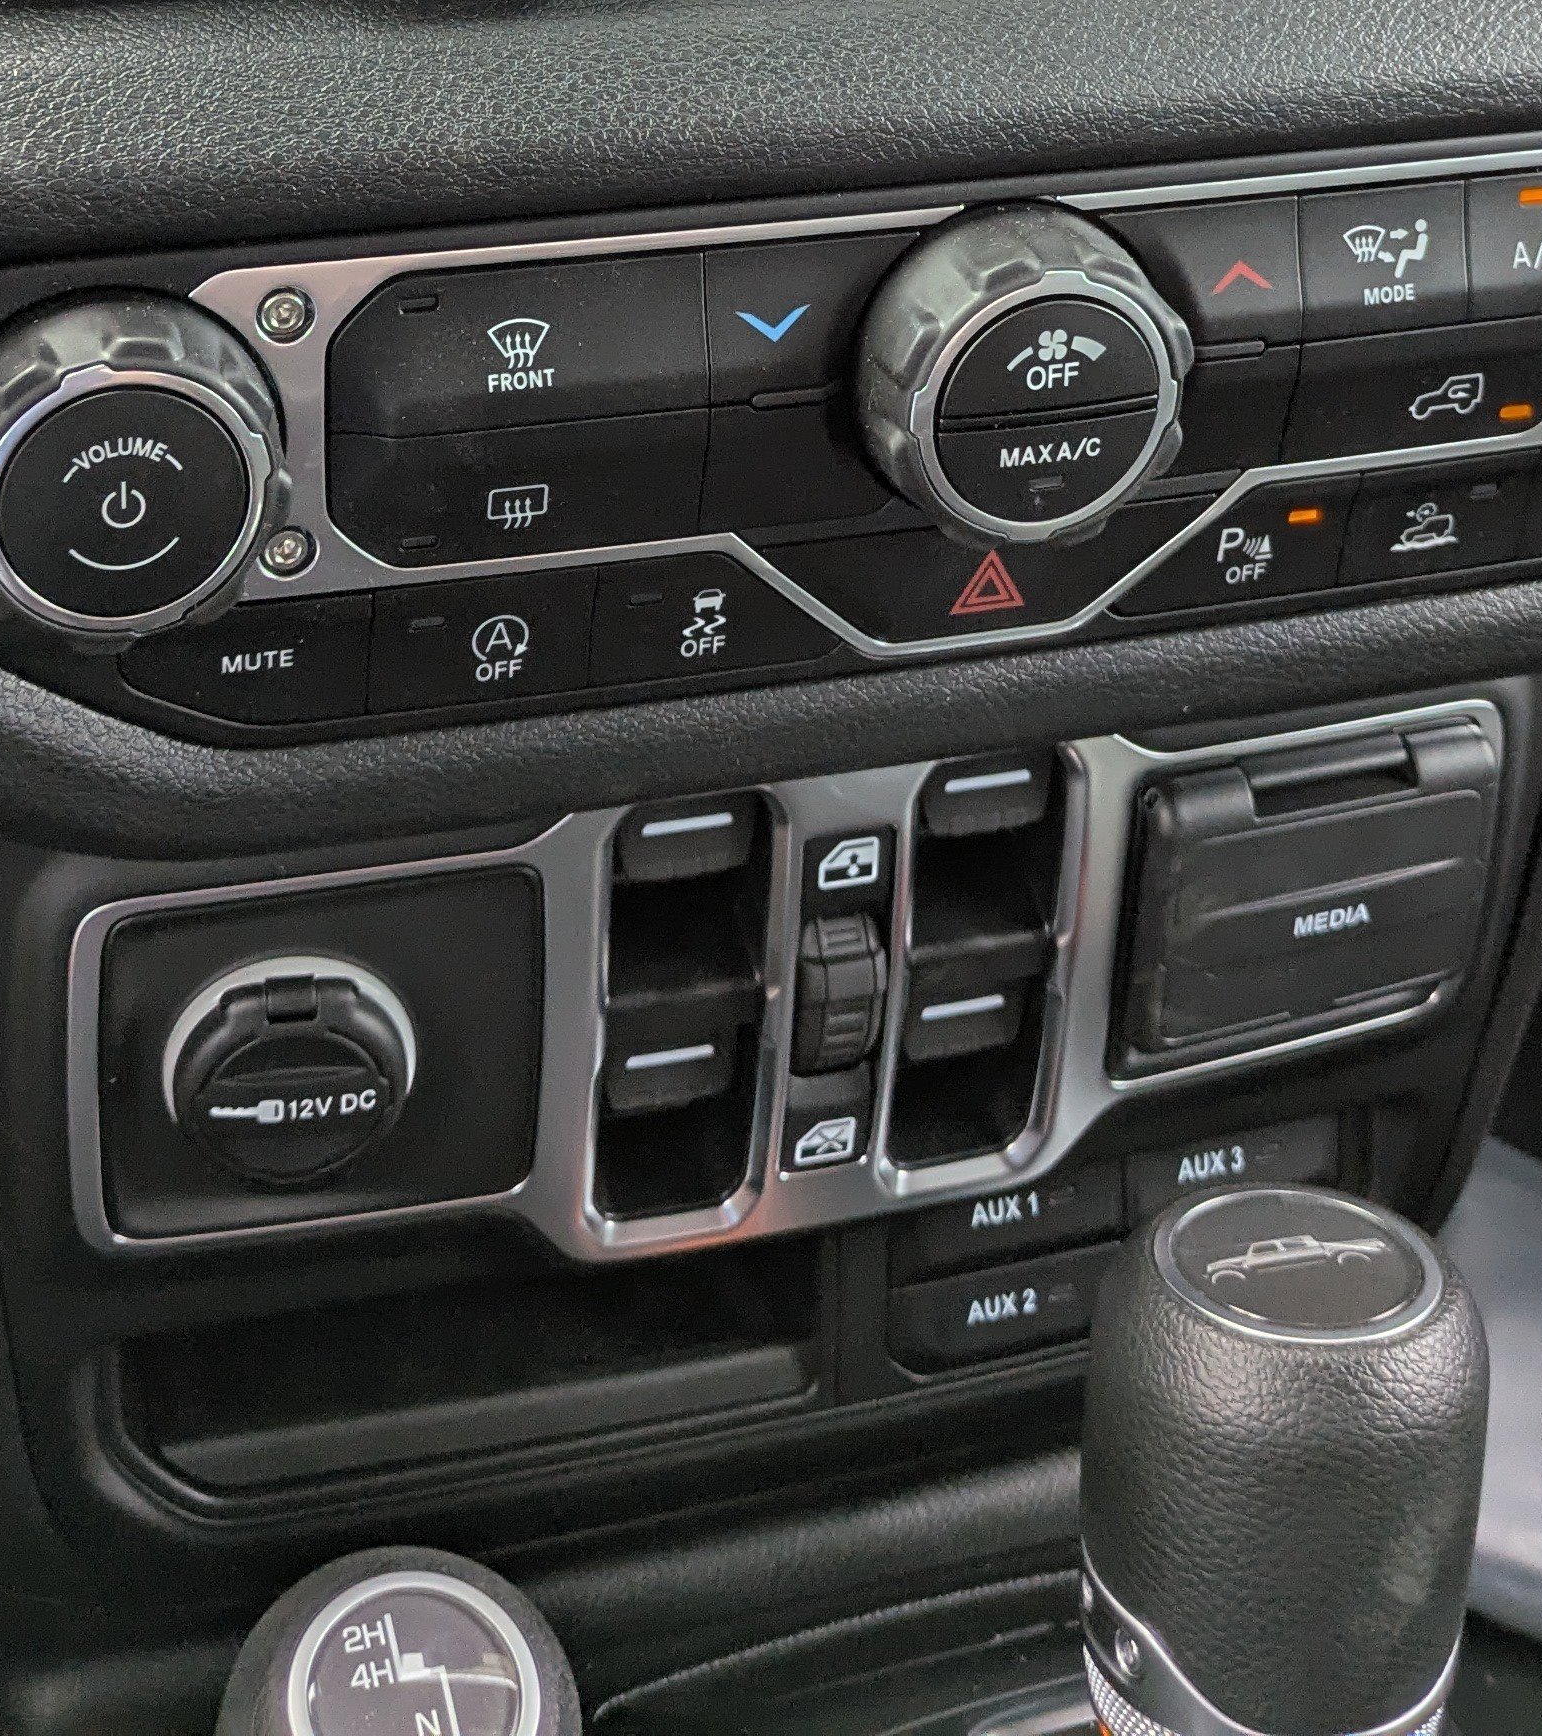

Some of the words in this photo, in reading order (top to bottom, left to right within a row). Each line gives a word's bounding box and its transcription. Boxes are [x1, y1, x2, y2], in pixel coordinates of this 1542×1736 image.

[1362, 282, 1415, 306] MODE
[487, 368, 555, 393] FRONT
[1026, 360, 1080, 392] OFF
[74, 438, 169, 472] VOLUME
[999, 440, 1055, 469] MAX
[1056, 434, 1102, 464] A/C
[1226, 561, 1265, 584] OFF
[221, 647, 295, 675] MUTE
[681, 632, 727, 658] OFF
[475, 656, 523, 682] OFF
[1293, 902, 1371, 939] MEDIA
[288, 1096, 334, 1120] 12V
[340, 1090, 378, 1115] DC
[1178, 1150, 1227, 1185] AUX
[1230, 1146, 1246, 1175] 3
[971, 1196, 1023, 1228] AUX
[1028, 1193, 1040, 1221] 1
[967, 1292, 1017, 1325] AUX
[1020, 1288, 1038, 1316] 2
[342, 1620, 386, 1653] 2H
[350, 1657, 396, 1690] 4H
